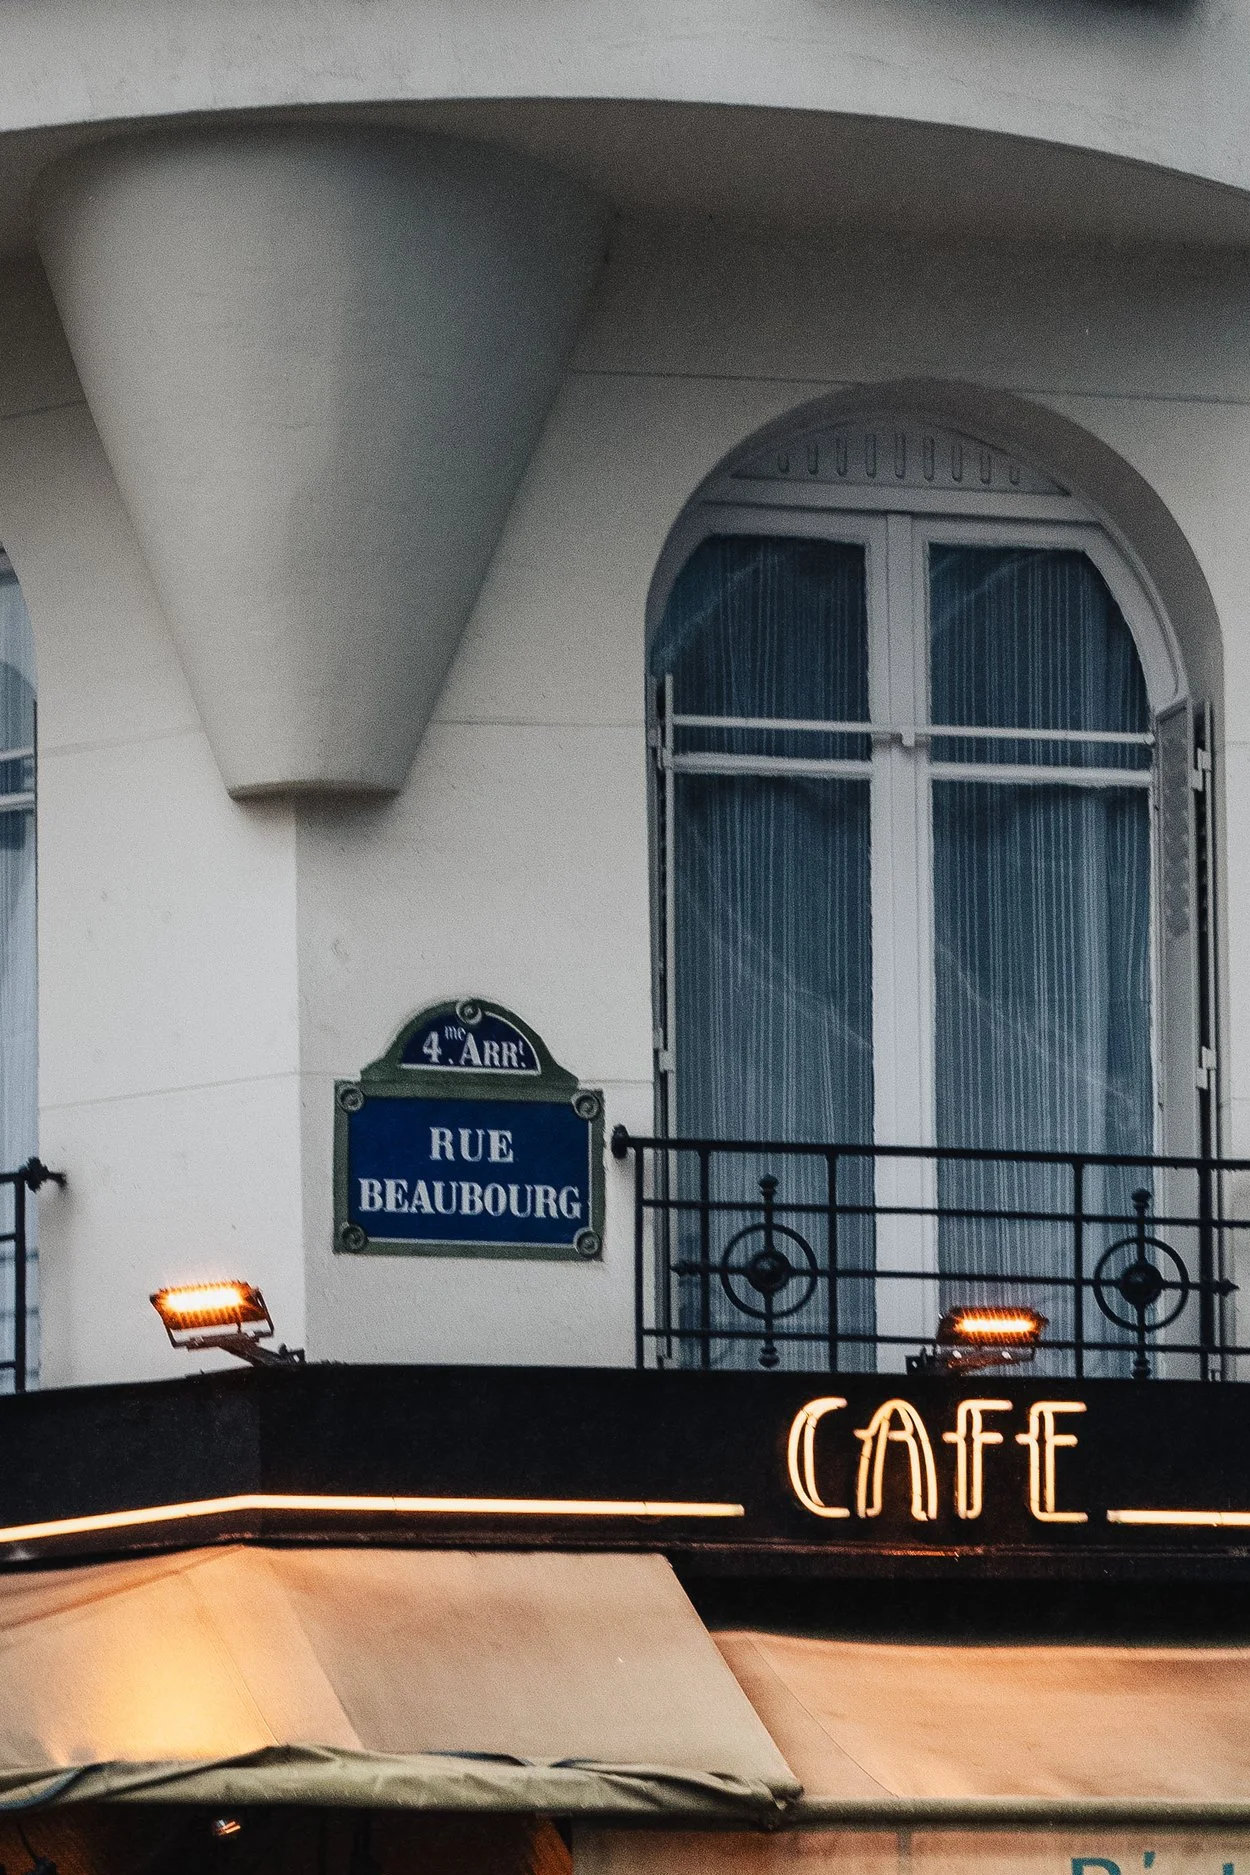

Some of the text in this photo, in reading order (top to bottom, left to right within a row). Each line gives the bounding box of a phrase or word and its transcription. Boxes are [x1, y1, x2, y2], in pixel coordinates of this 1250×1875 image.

[428, 1125, 515, 1164] RUE
[357, 1177, 582, 1219] BEAUBOURG
[787, 1397, 1089, 1522] CAFE
